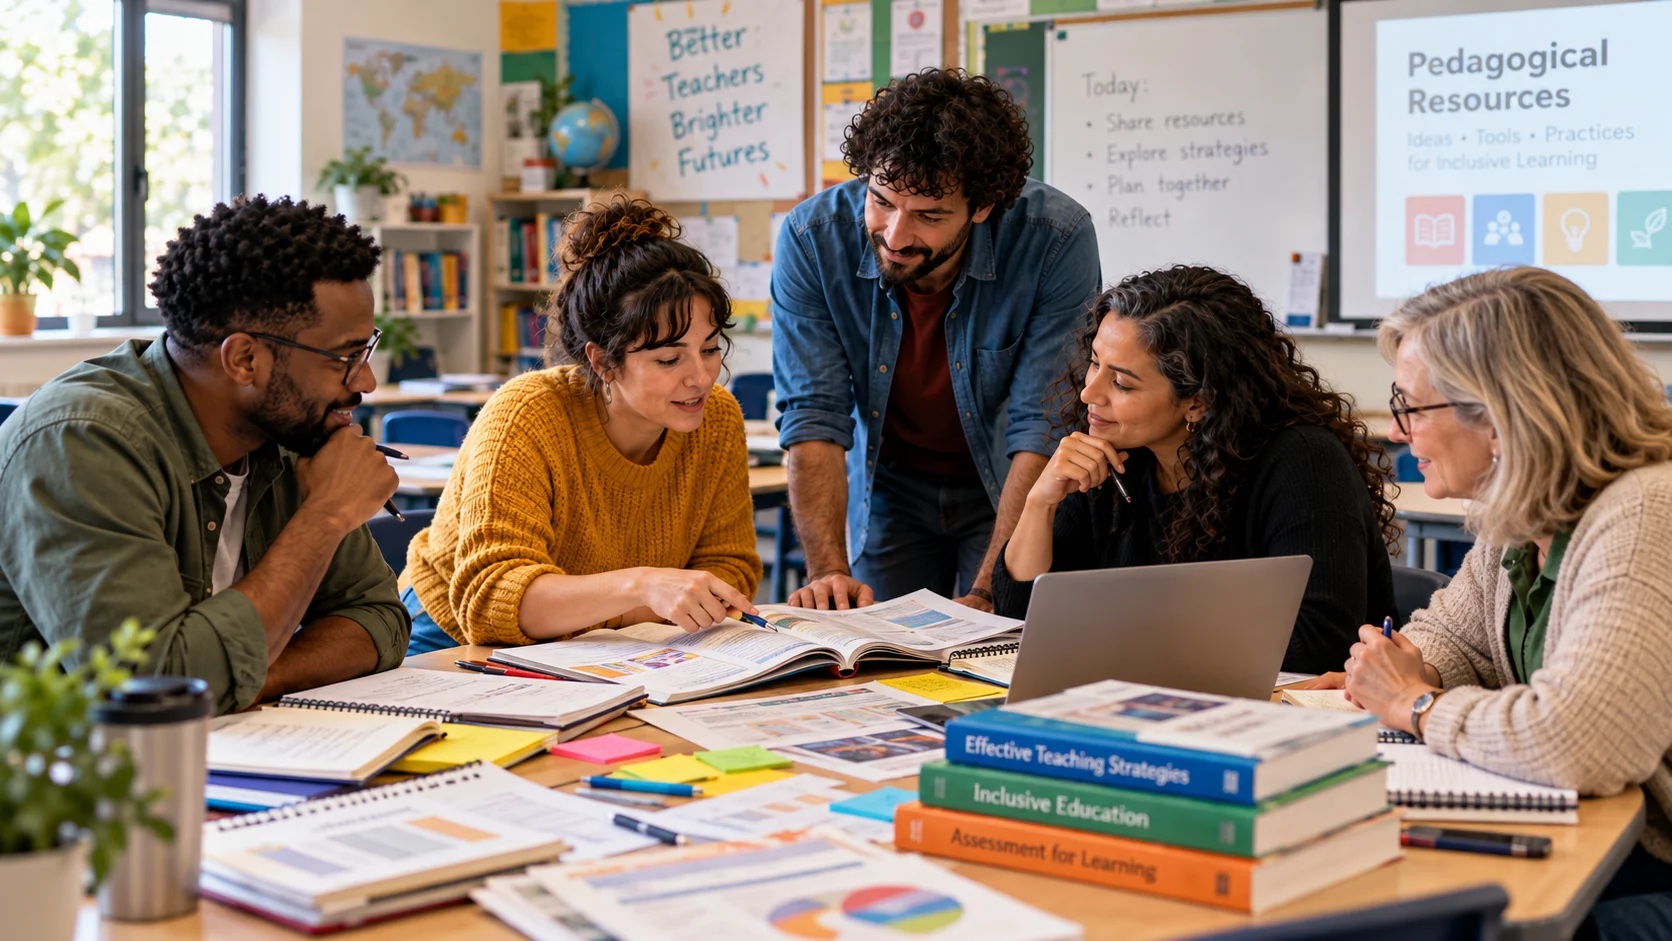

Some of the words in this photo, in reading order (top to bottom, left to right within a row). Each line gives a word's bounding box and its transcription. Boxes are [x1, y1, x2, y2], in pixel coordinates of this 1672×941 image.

[1408, 38, 1608, 80] Pedagogical
[661, 63, 764, 101] Teachers
[1081, 71, 1149, 104] Today:
[1408, 87, 1571, 115] Resources
[670, 101, 768, 142] Brighter
[1105, 112, 1154, 133] Share
[1164, 110, 1246, 129] resources
[1407, 132, 1453, 148] Ideas
[1475, 128, 1521, 146] Tools
[1545, 123, 1635, 143] Practices
[677, 140, 770, 178] Futures
[1106, 143, 1168, 170] Explore
[1180, 138, 1269, 166] strategies
[1407, 154, 1430, 172] for
[1436, 153, 1510, 171] Inclusive
[1517, 149, 1598, 170] Learning
[1107, 174, 1145, 196] Plan
[1158, 172, 1231, 201] together
[1108, 207, 1173, 229] Reflect
[965, 734, 1032, 763] Effective
[1035, 745, 1105, 777] Teaching
[1107, 755, 1190, 787] Strategies
[974, 783, 1051, 812] Inclusive
[1056, 796, 1149, 830] Education
[951, 827, 1046, 862] Assessment
[1051, 844, 1076, 864] for
[1081, 850, 1157, 883] Learning
